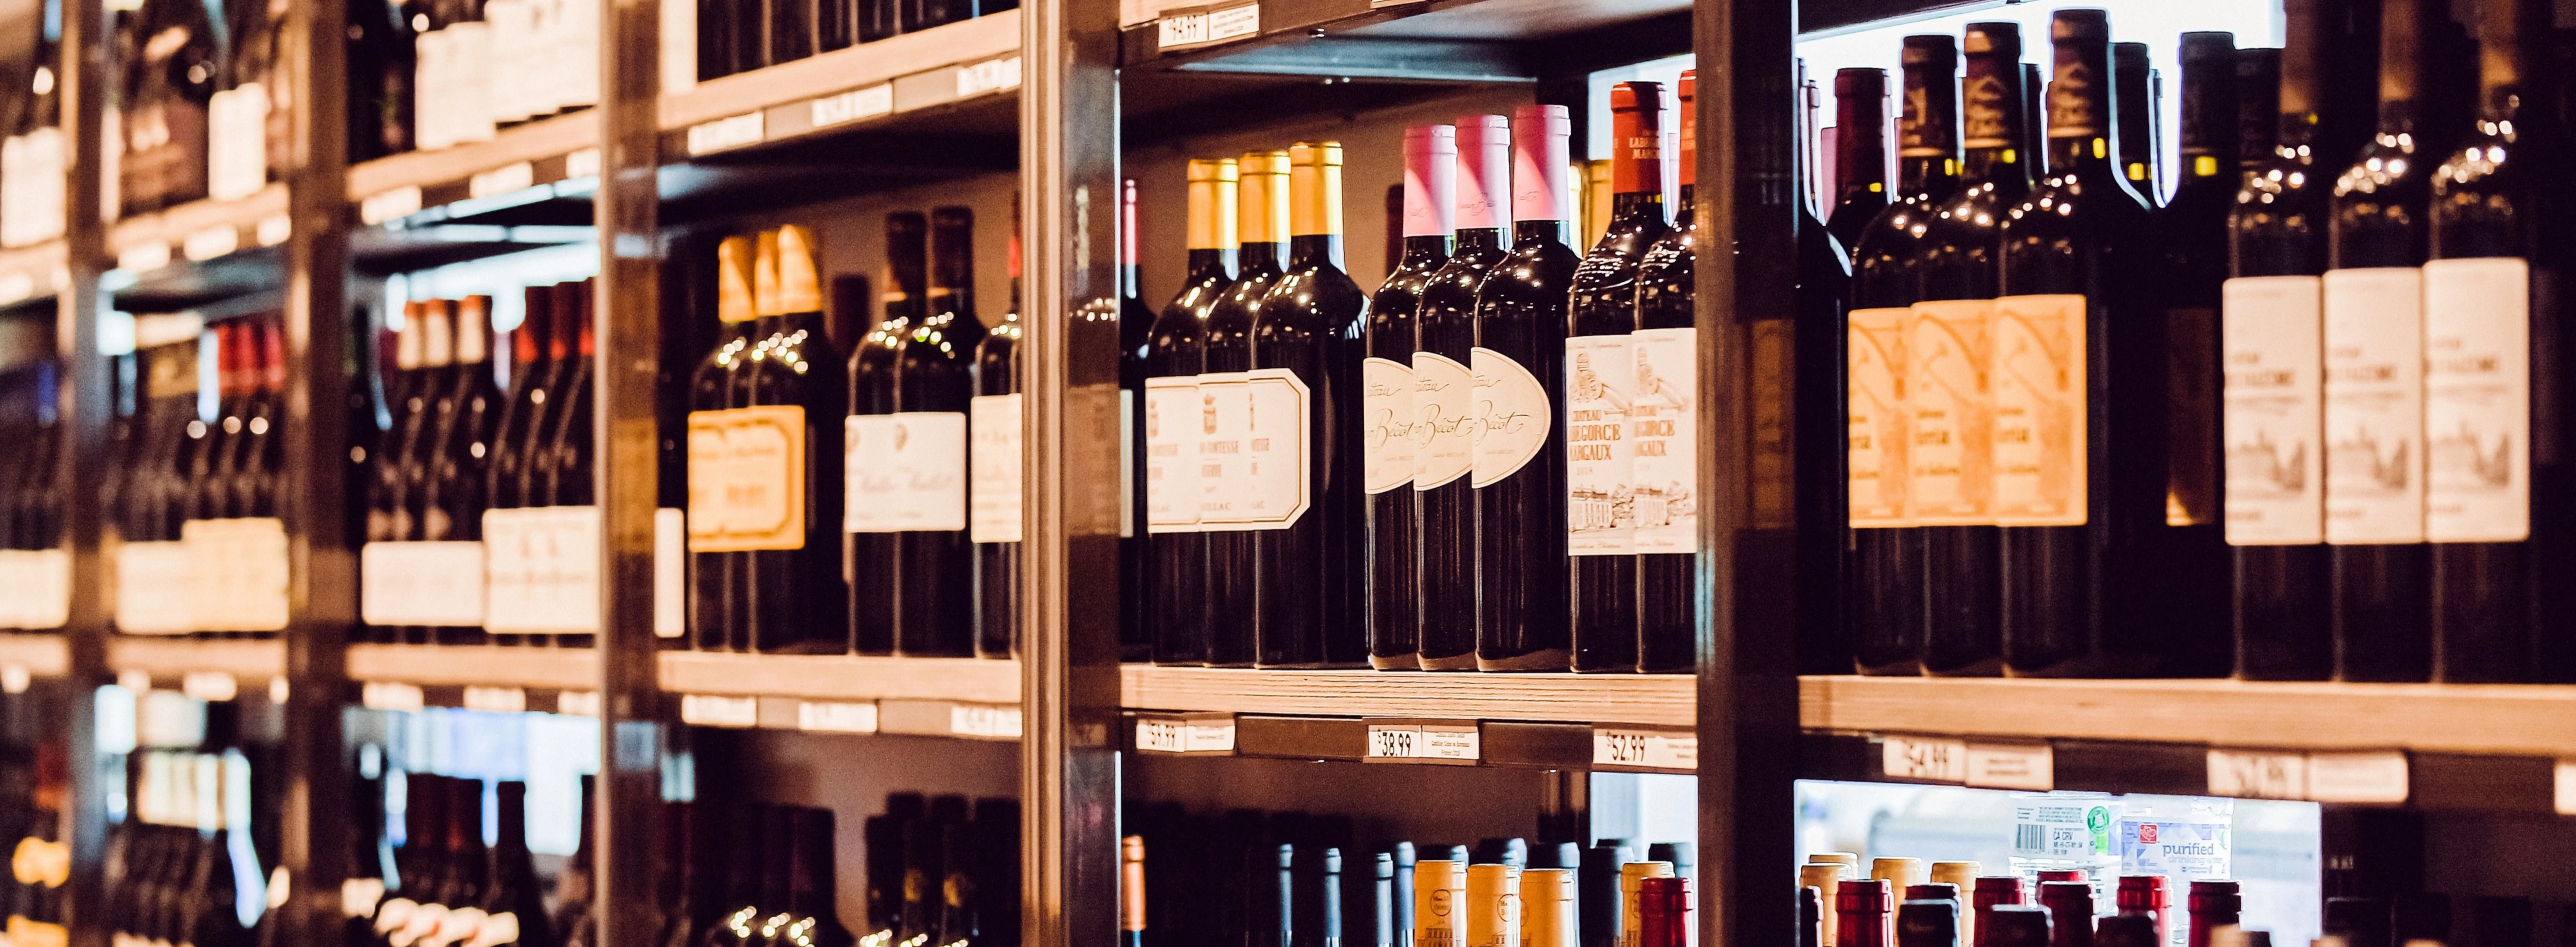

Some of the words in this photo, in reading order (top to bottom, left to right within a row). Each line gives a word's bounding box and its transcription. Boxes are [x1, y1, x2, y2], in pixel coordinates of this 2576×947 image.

[1377, 728, 1411, 757] $38.99
[1607, 731, 1645, 761] $52.99
[2163, 843, 2214, 857] purified
